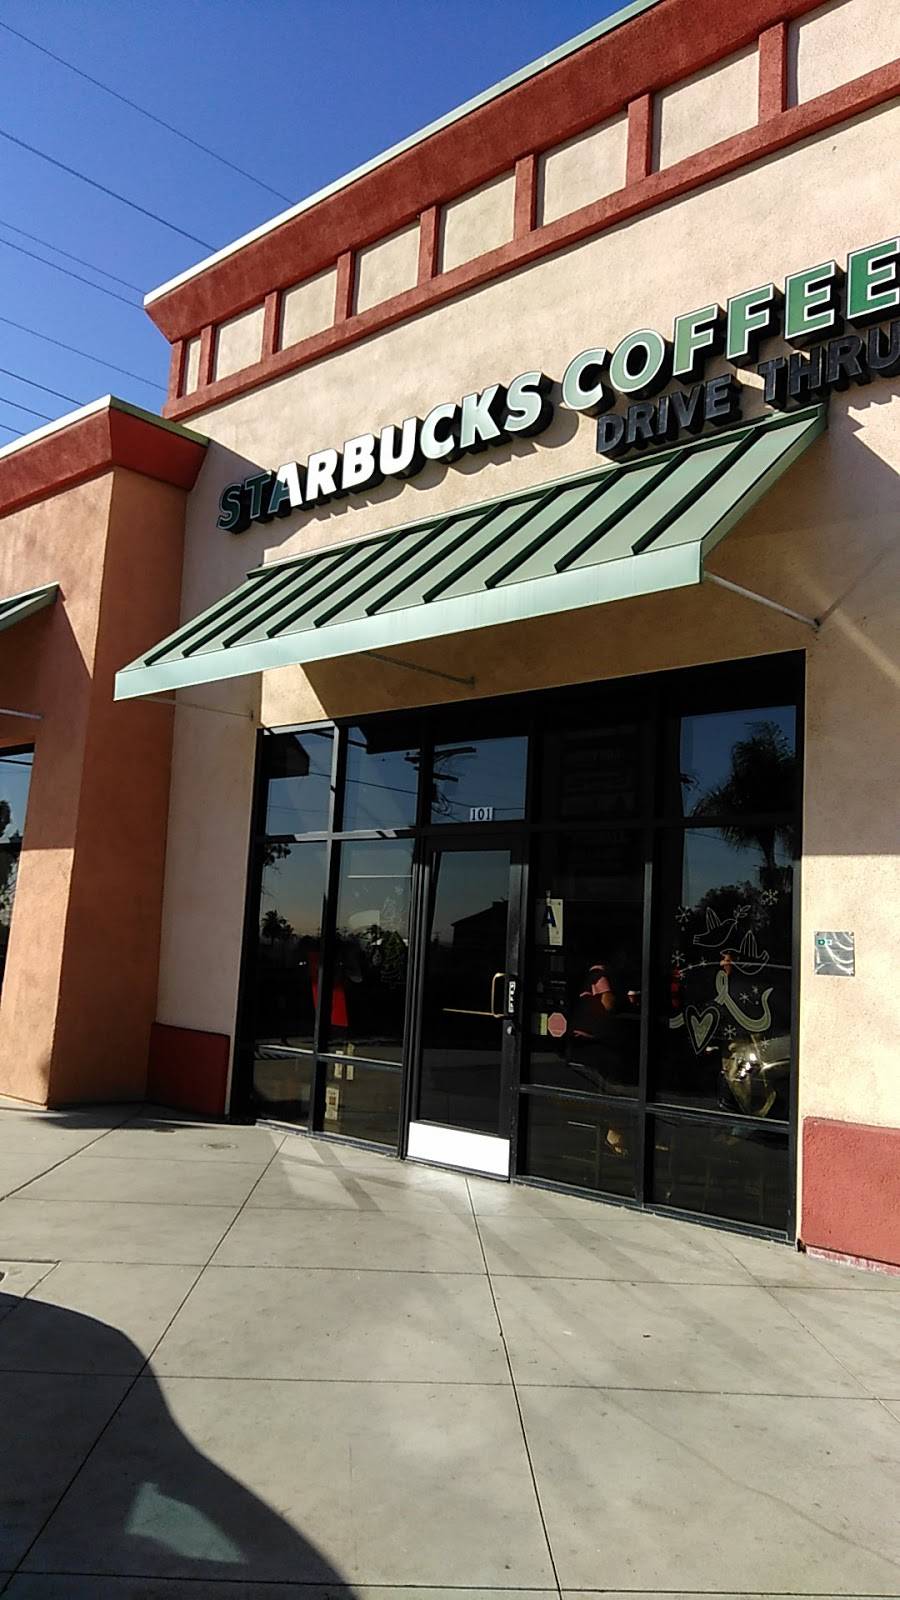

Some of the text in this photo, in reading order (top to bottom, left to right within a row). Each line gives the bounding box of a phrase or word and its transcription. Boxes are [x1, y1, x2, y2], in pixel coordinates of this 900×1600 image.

[216, 236, 900, 530] STARBUCKS COFFEE
[597, 320, 900, 454] DRIVE THRU
[470, 807, 492, 821] 101
